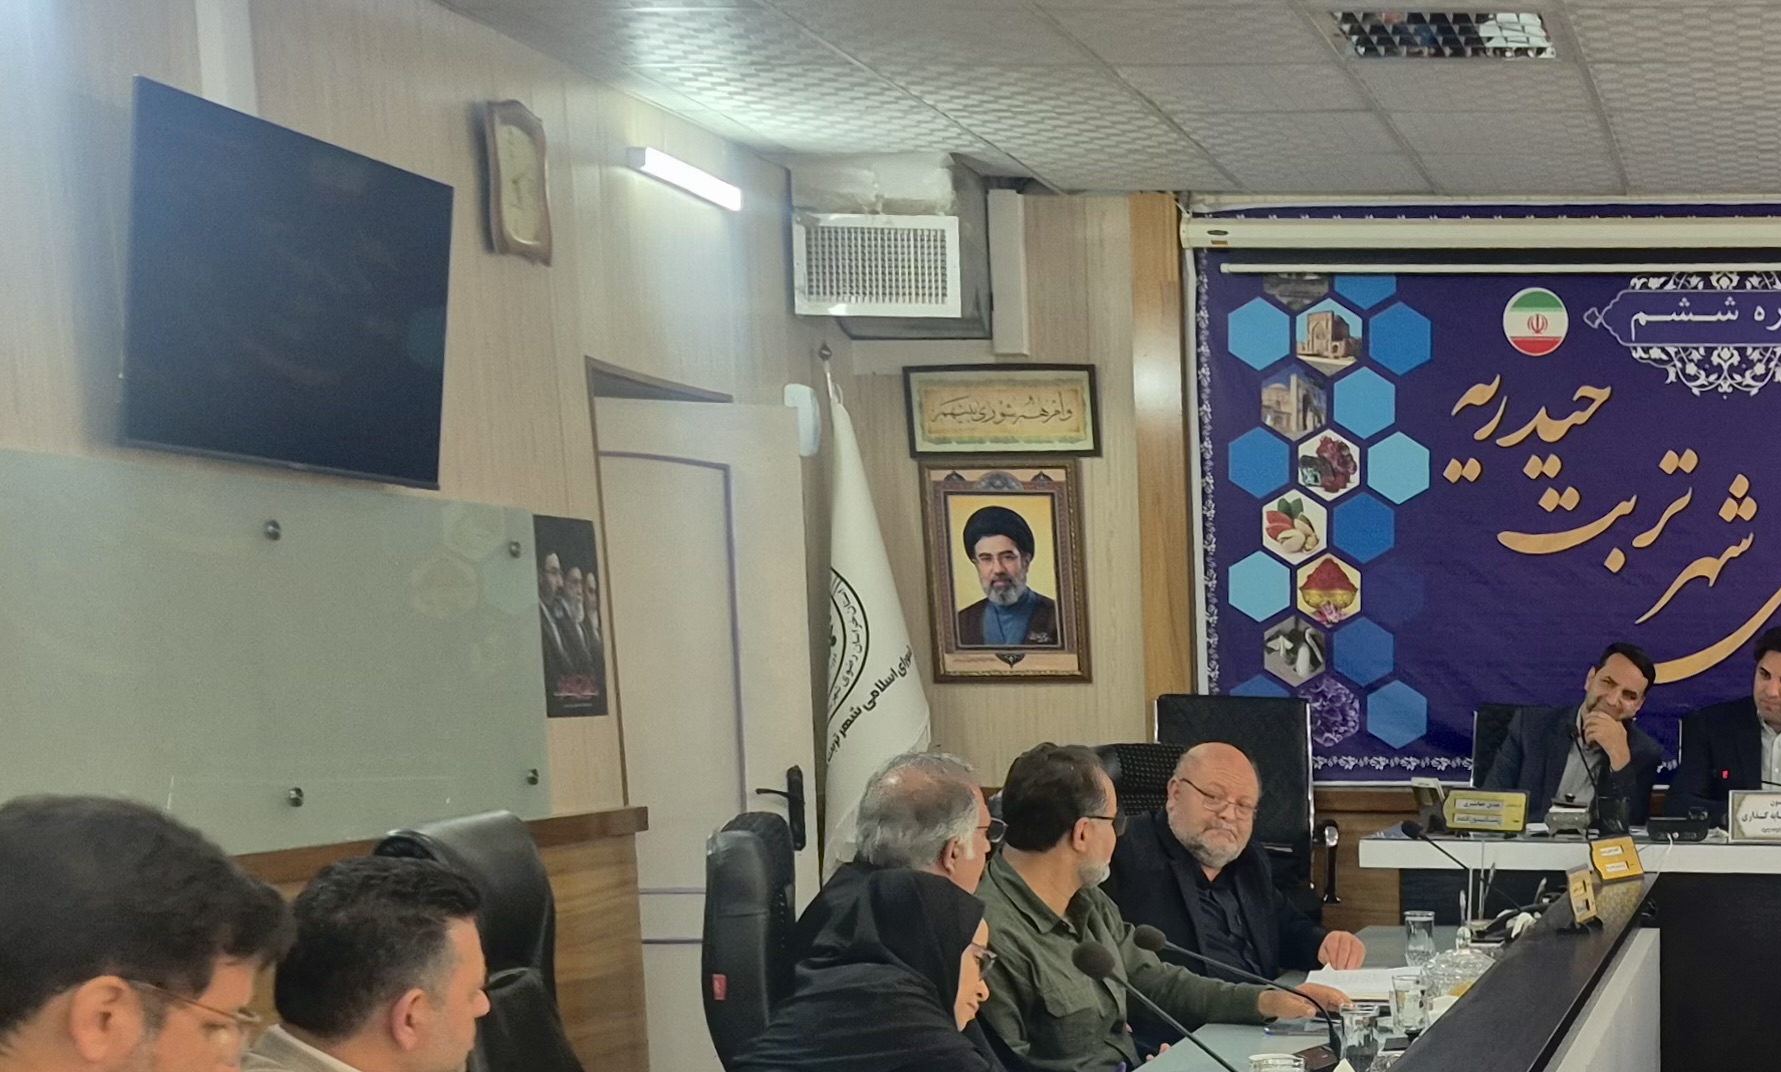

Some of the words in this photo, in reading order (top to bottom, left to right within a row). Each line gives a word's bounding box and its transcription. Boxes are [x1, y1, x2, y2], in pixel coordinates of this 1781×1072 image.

[1631, 297, 1739, 342] ششم
[1443, 374, 1612, 483] حیدریه
[1496, 448, 1699, 574] تربت
[1634, 473, 1758, 625] شهر
[839, 706, 862, 738] شهر
[862, 667, 899, 711] اسلامی
